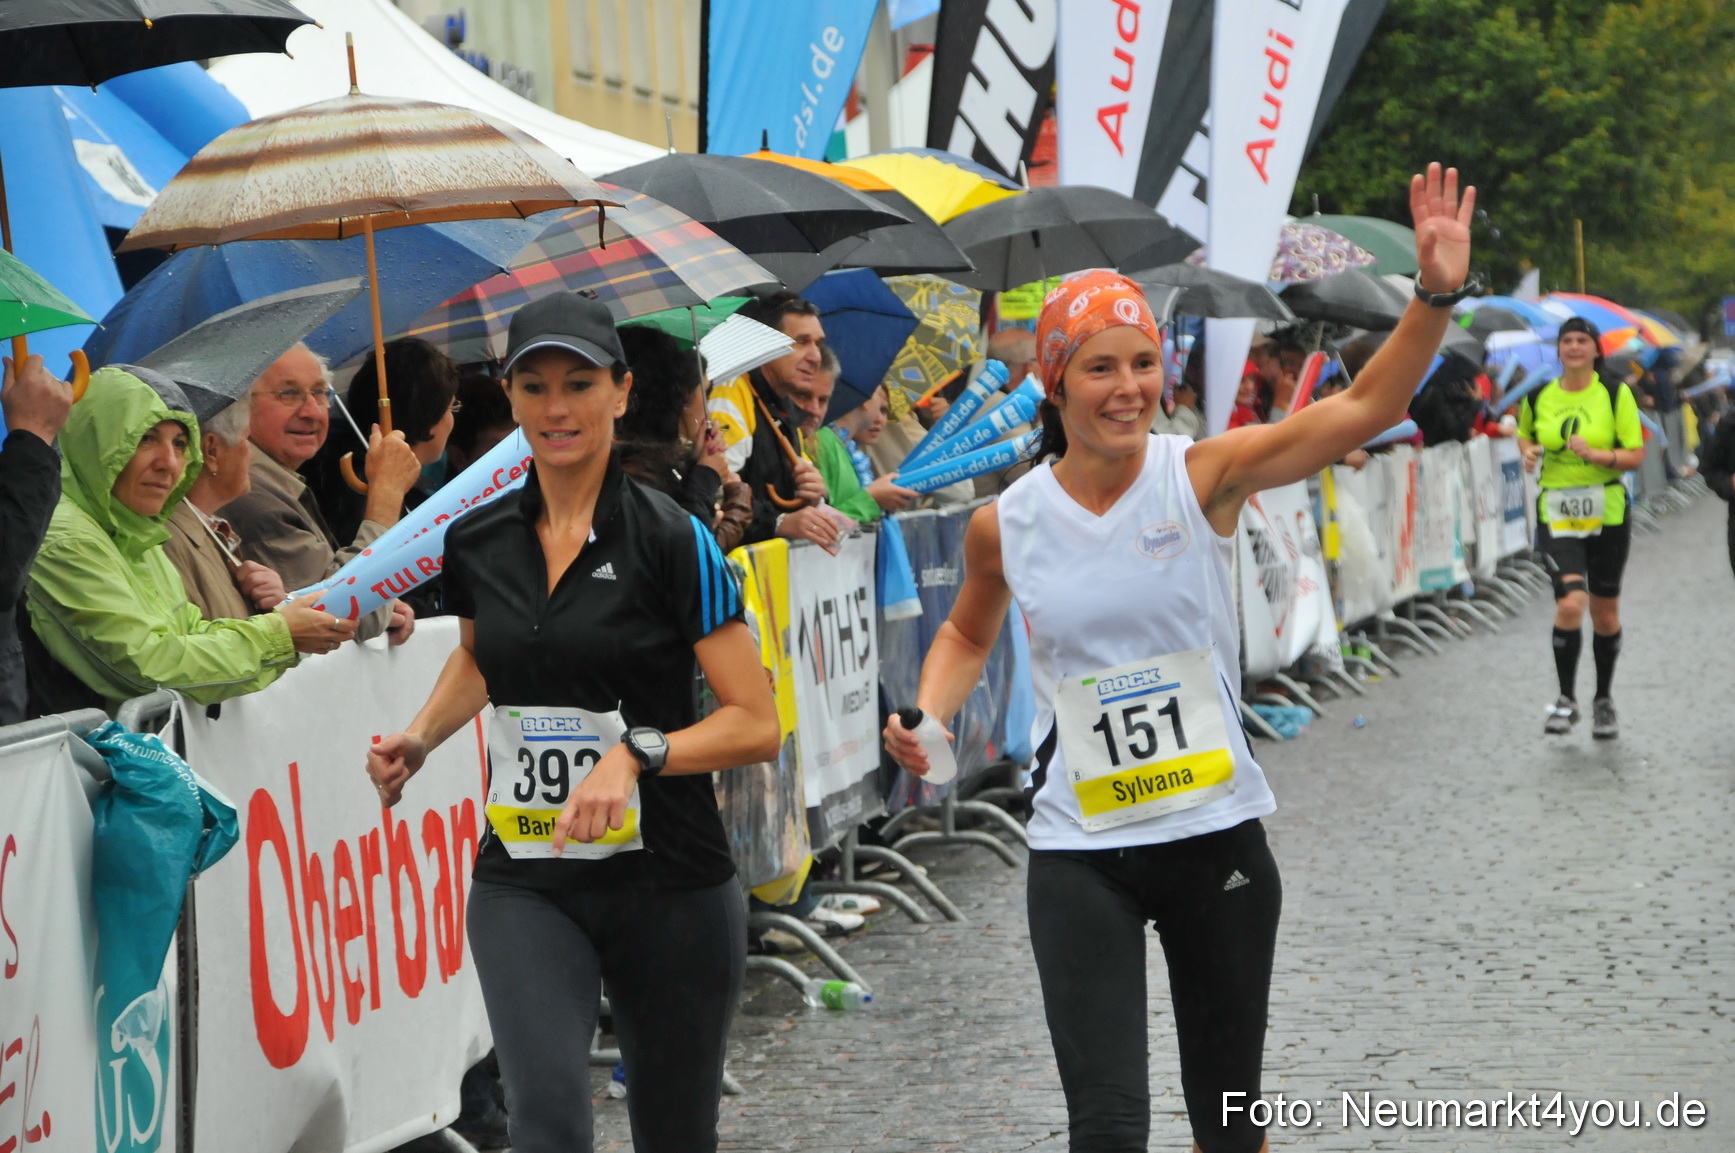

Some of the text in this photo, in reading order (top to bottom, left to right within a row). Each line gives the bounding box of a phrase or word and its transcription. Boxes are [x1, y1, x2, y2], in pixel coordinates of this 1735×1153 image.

[1245, 28, 1295, 185] Audi
[1560, 498, 1593, 517] 430
[370, 567, 419, 599] TUI
[592, 571, 617, 580] adidas
[1097, 668, 1162, 695] BOCK
[521, 717, 582, 731] BOCK
[1093, 696, 1188, 767] 151
[1112, 768, 1194, 803] Sylvana
